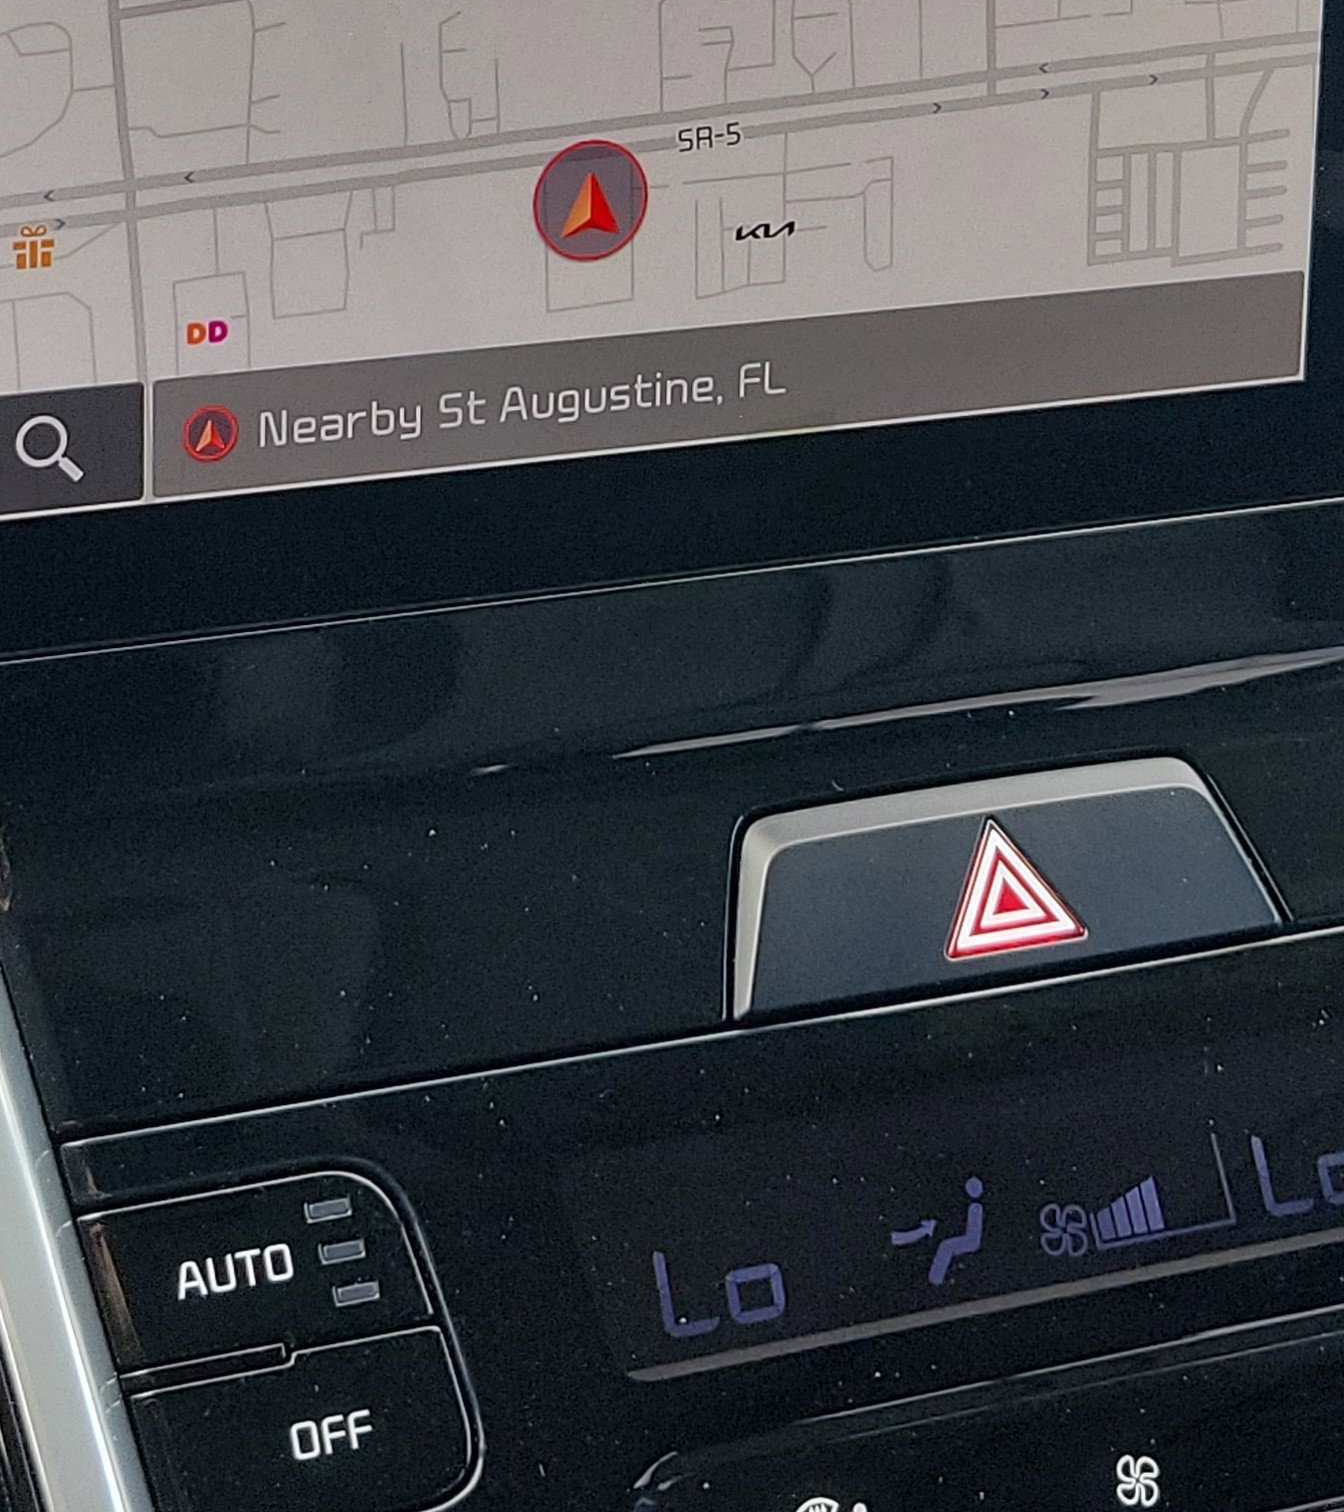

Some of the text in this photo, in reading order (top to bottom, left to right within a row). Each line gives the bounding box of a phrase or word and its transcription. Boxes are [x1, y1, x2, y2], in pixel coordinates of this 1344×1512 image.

[678, 121, 741, 153] SR-5
[259, 361, 787, 448] Nearby St Augustine, FL
[177, 1243, 294, 1301] AUTO
[289, 1409, 373, 1461] OFF
